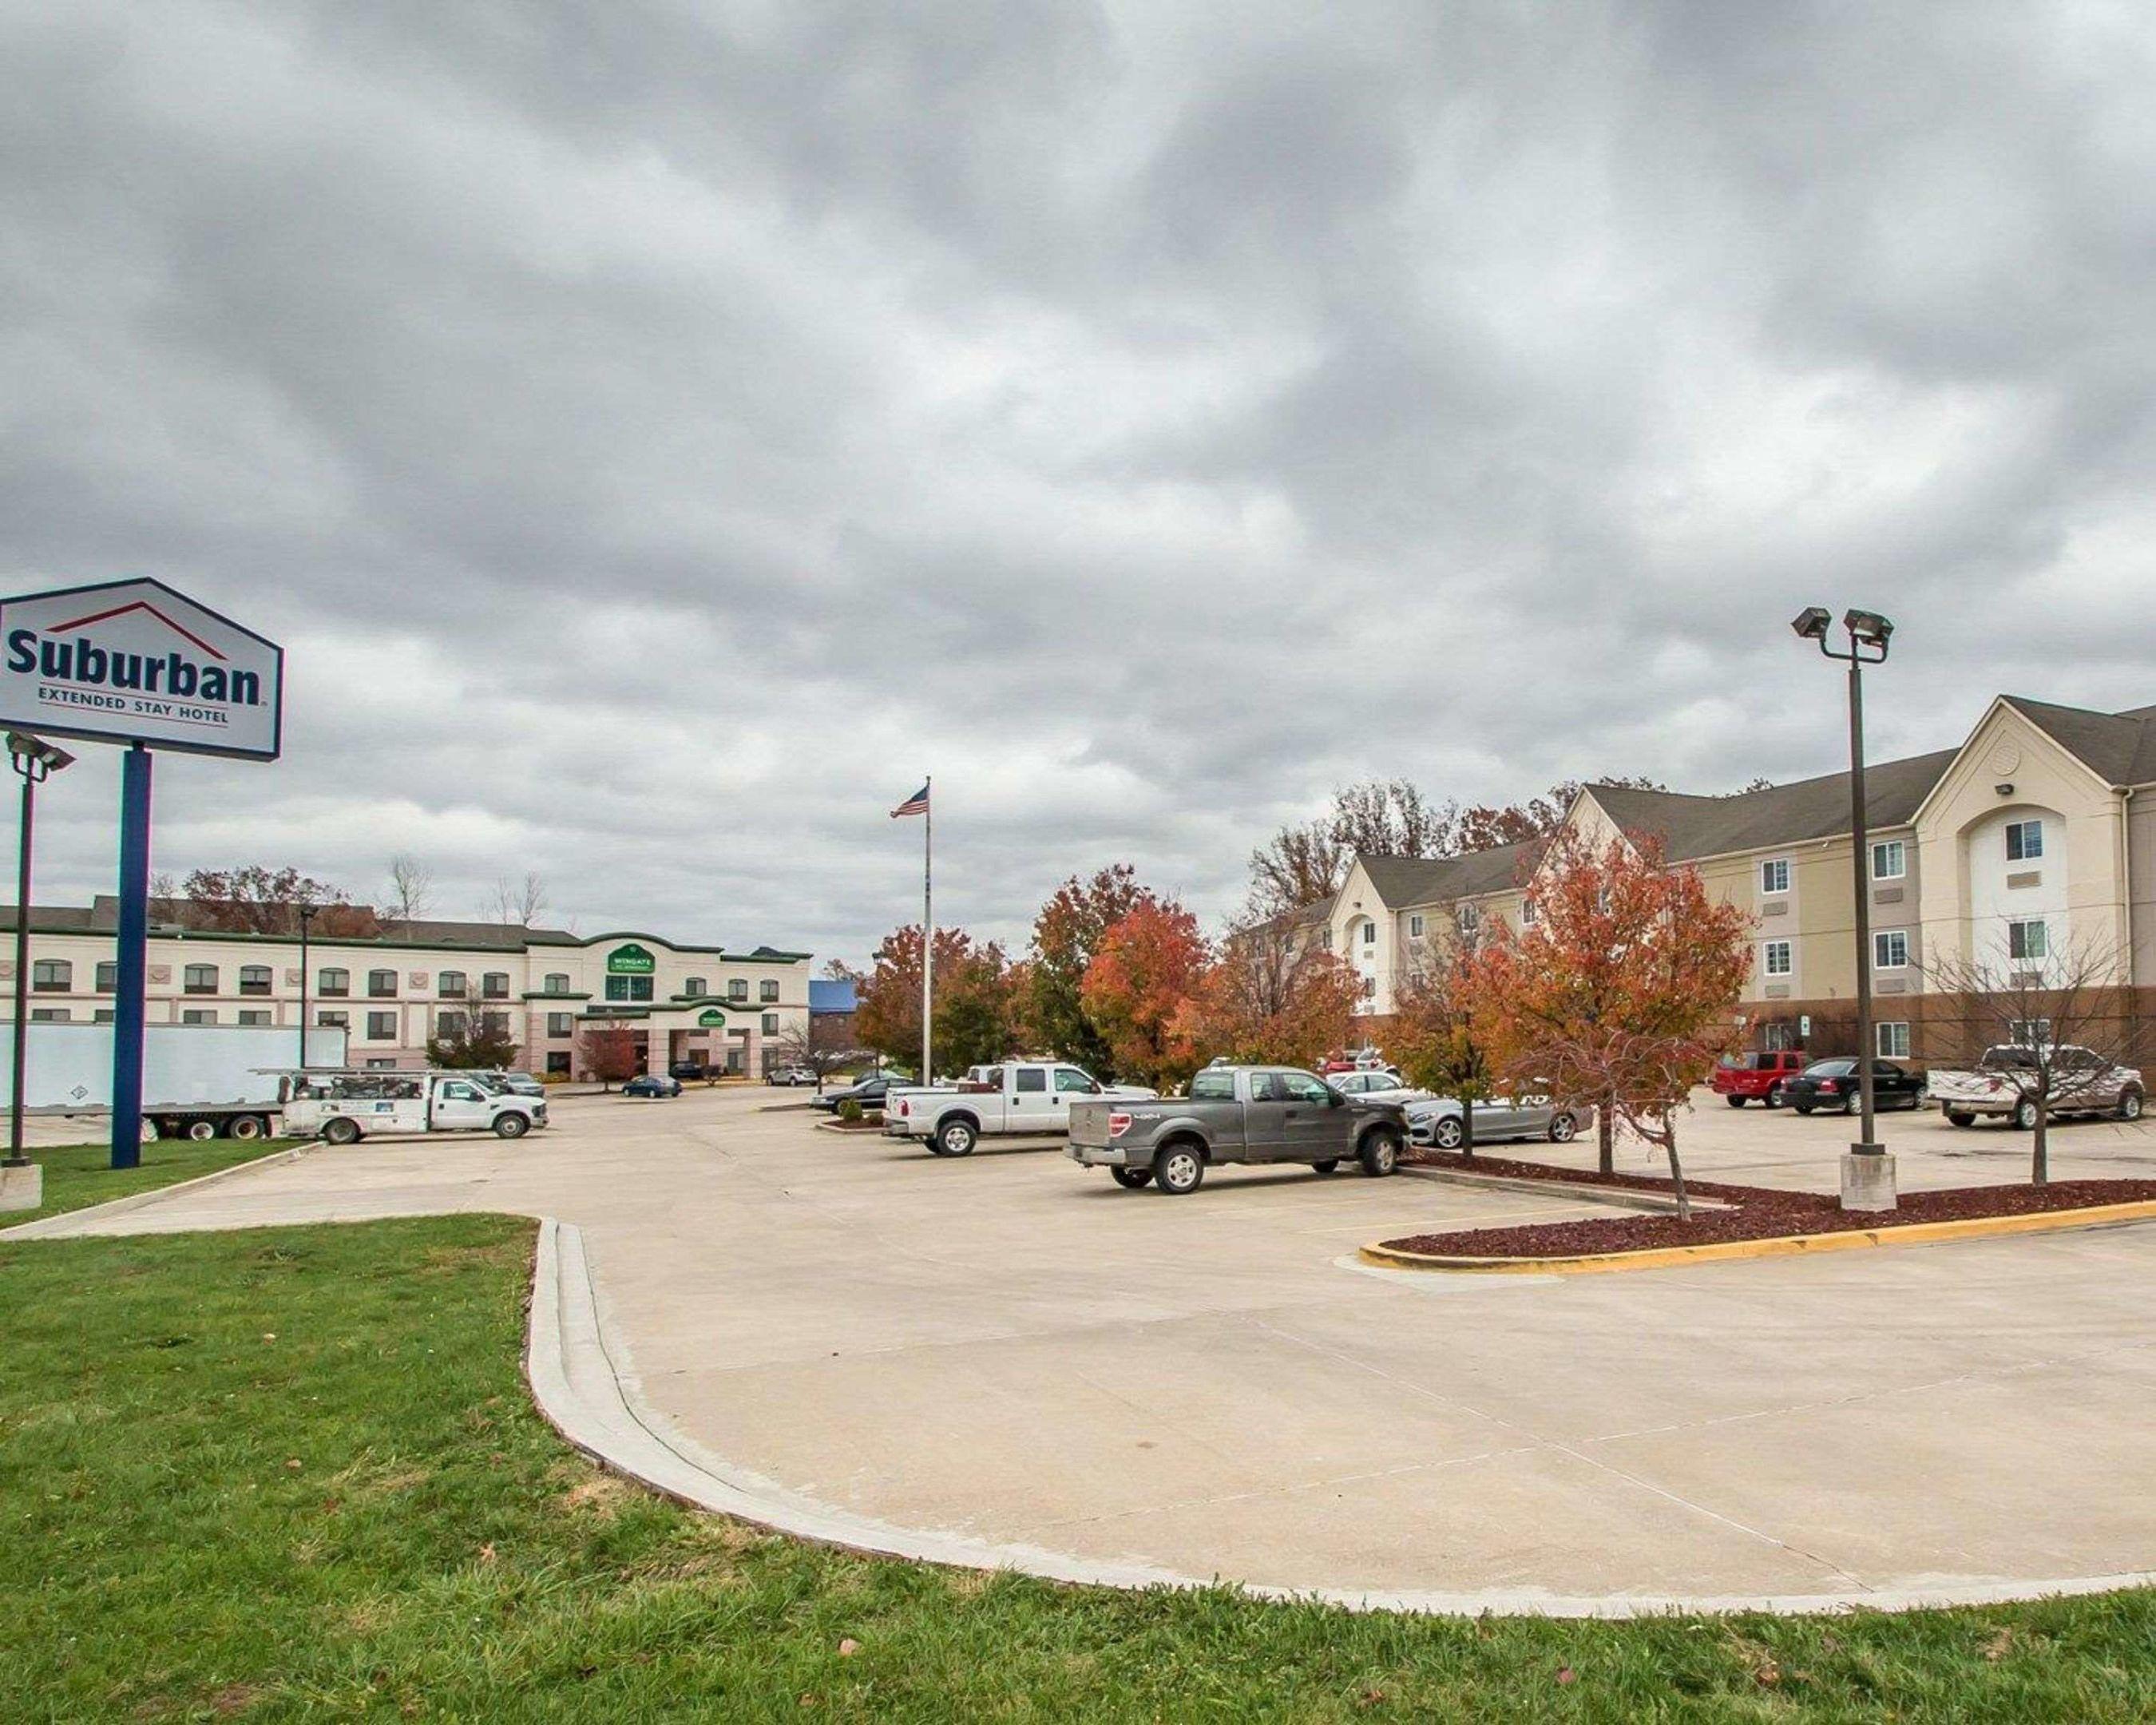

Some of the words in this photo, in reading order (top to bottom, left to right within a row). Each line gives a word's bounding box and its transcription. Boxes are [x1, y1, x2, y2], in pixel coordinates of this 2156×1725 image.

[7, 629, 260, 706] Suburban
[38, 687, 125, 709] EXTENDED
[134, 700, 172, 716] STAY
[180, 707, 228, 724] HOTEL
